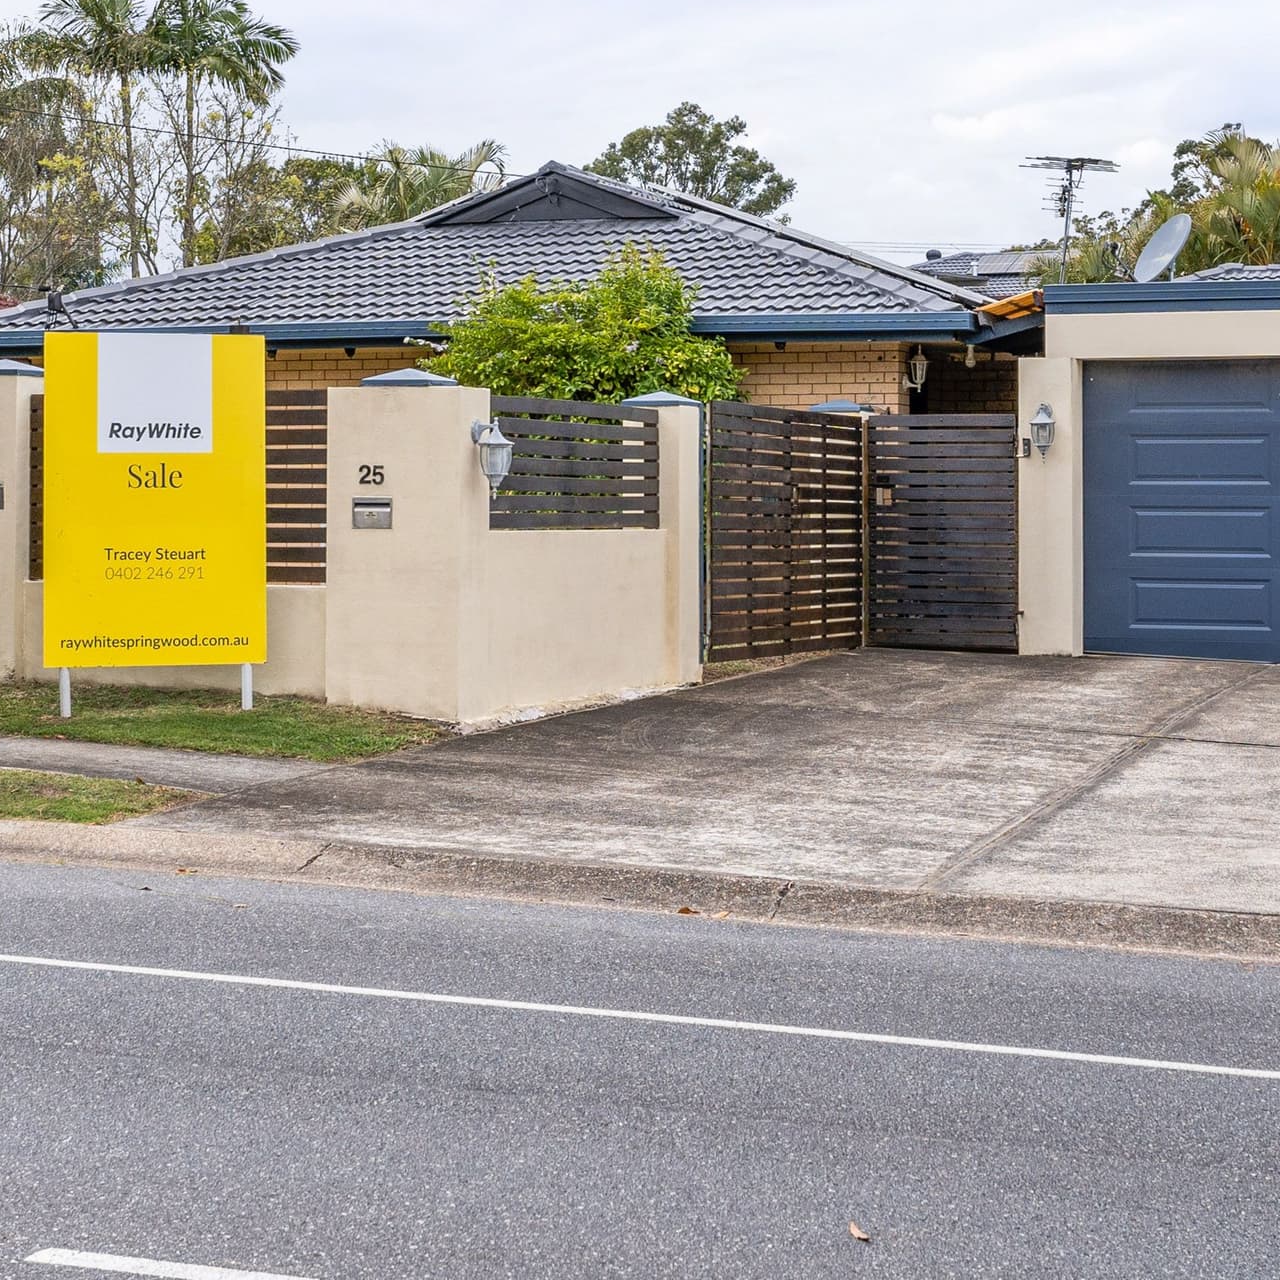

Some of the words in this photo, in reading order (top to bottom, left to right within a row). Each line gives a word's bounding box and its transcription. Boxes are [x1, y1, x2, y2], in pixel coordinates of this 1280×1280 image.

[127, 462, 184, 489] Sale
[358, 464, 385, 486] 25
[103, 547, 152, 563] Tracey
[154, 547, 207, 561] Steuart
[104, 566, 142, 581] 0402
[146, 566, 174, 580] 246
[177, 565, 205, 580] 291
[59, 634, 250, 650] raywhitespringwood.com.au
